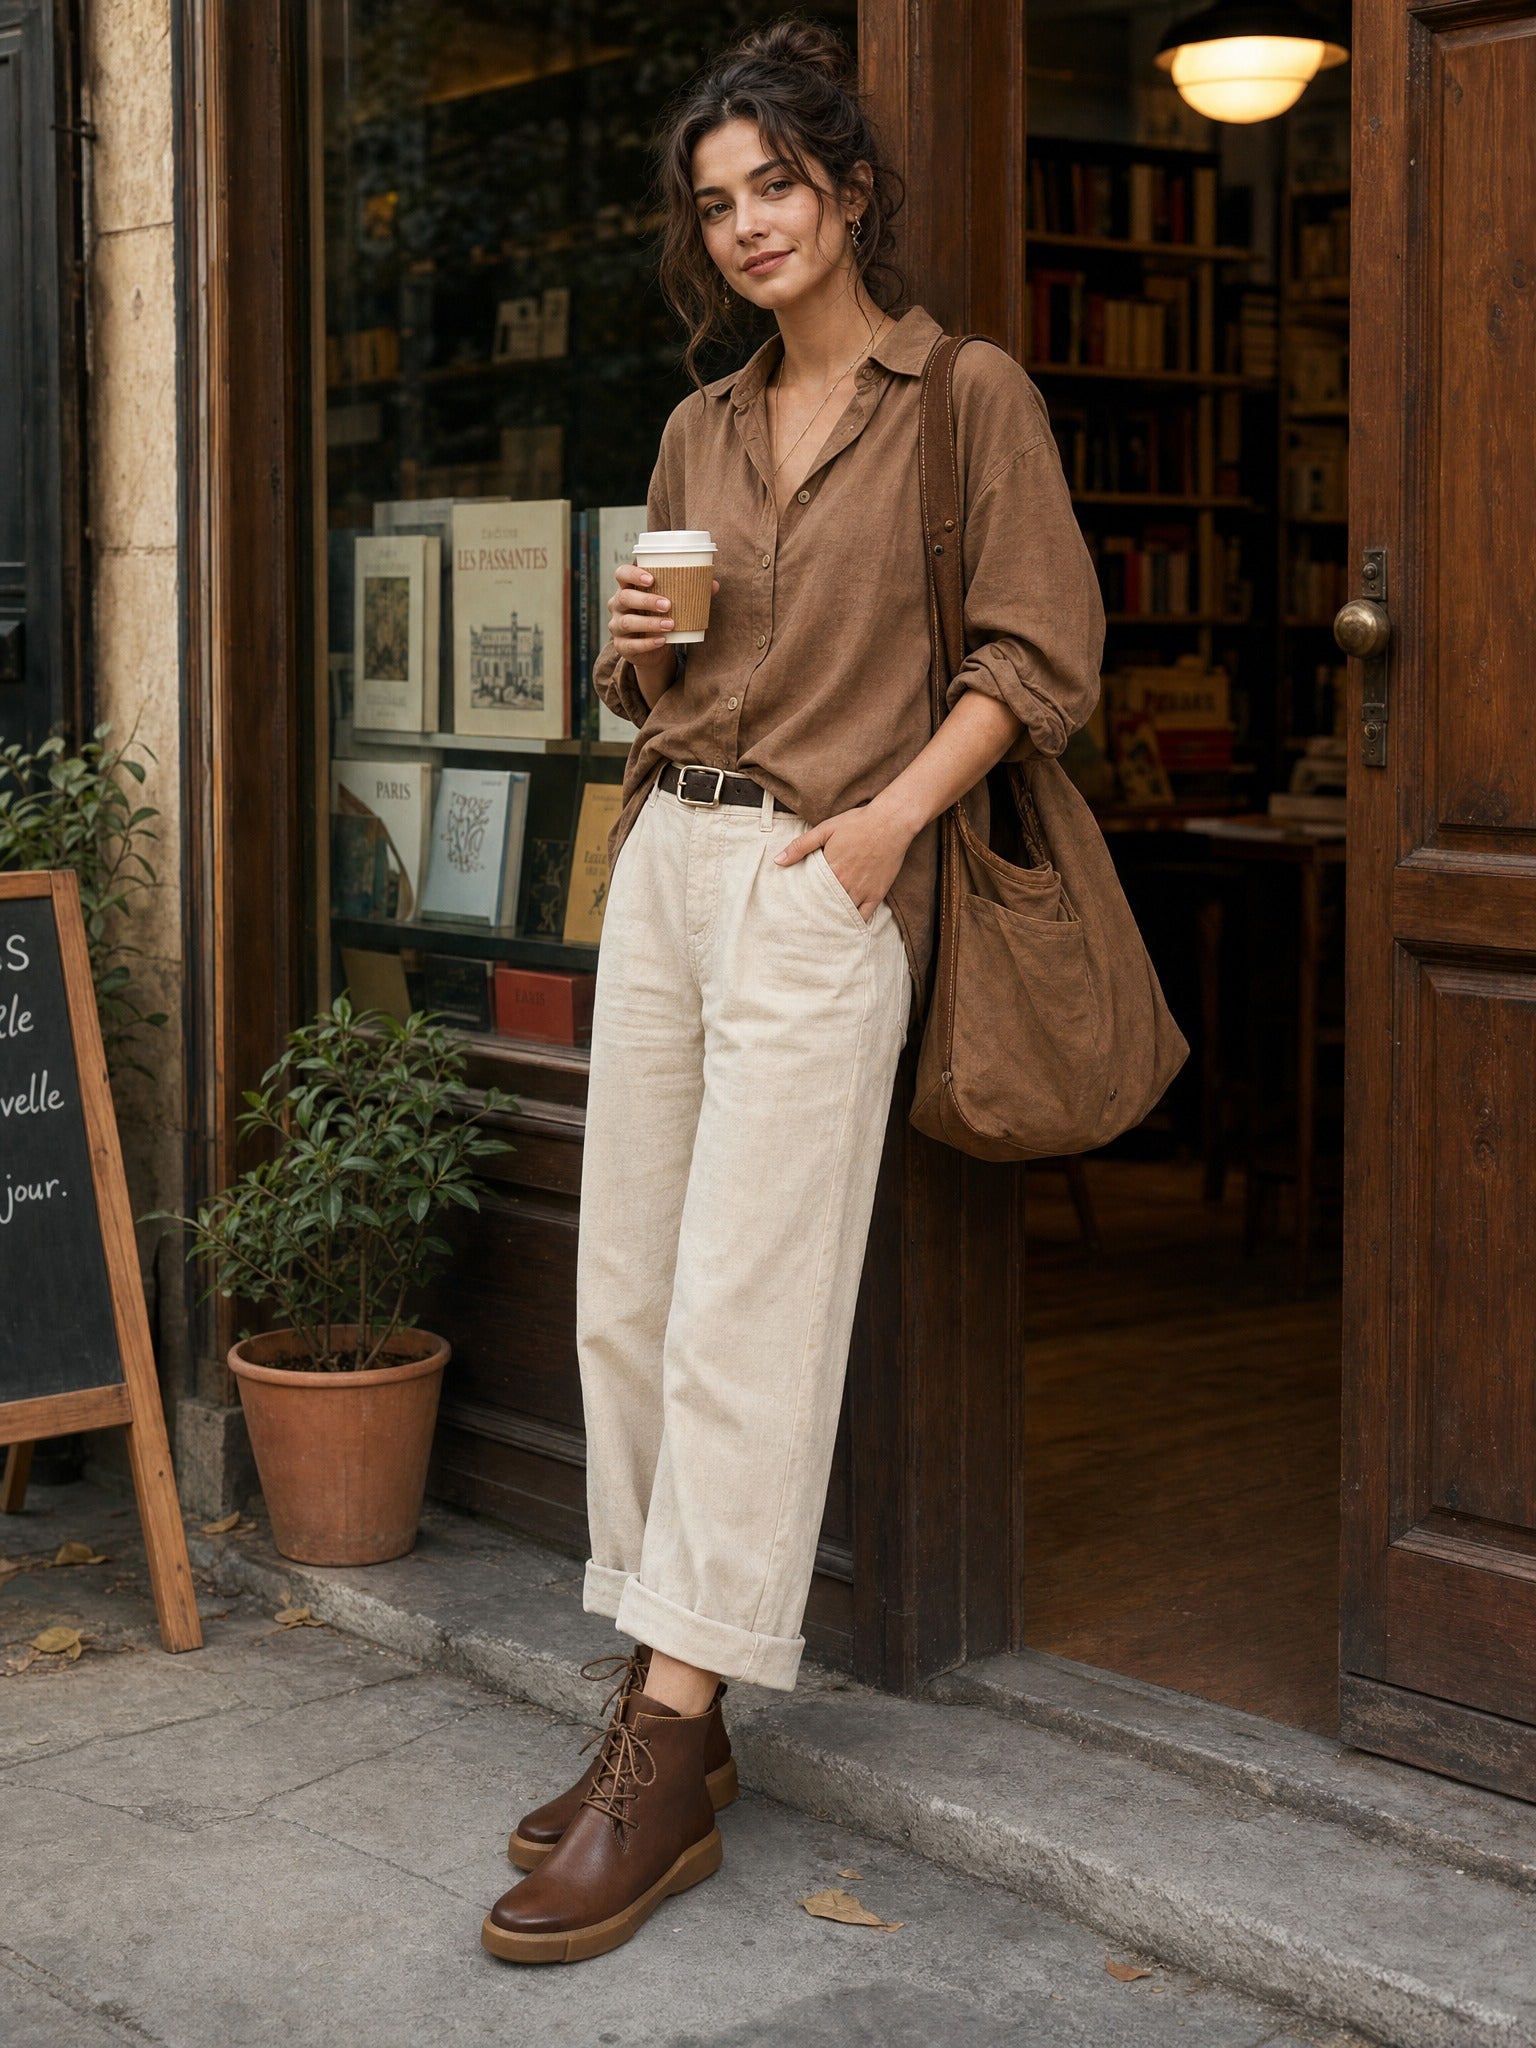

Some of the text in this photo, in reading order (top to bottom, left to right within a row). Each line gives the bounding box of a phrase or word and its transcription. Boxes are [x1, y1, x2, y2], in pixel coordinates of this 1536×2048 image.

[458, 547, 548, 571] LES PASSANTES
[376, 780, 411, 800] PARIS
[0, 1069, 65, 1117] velle
[0, 1173, 67, 1224] jour.
